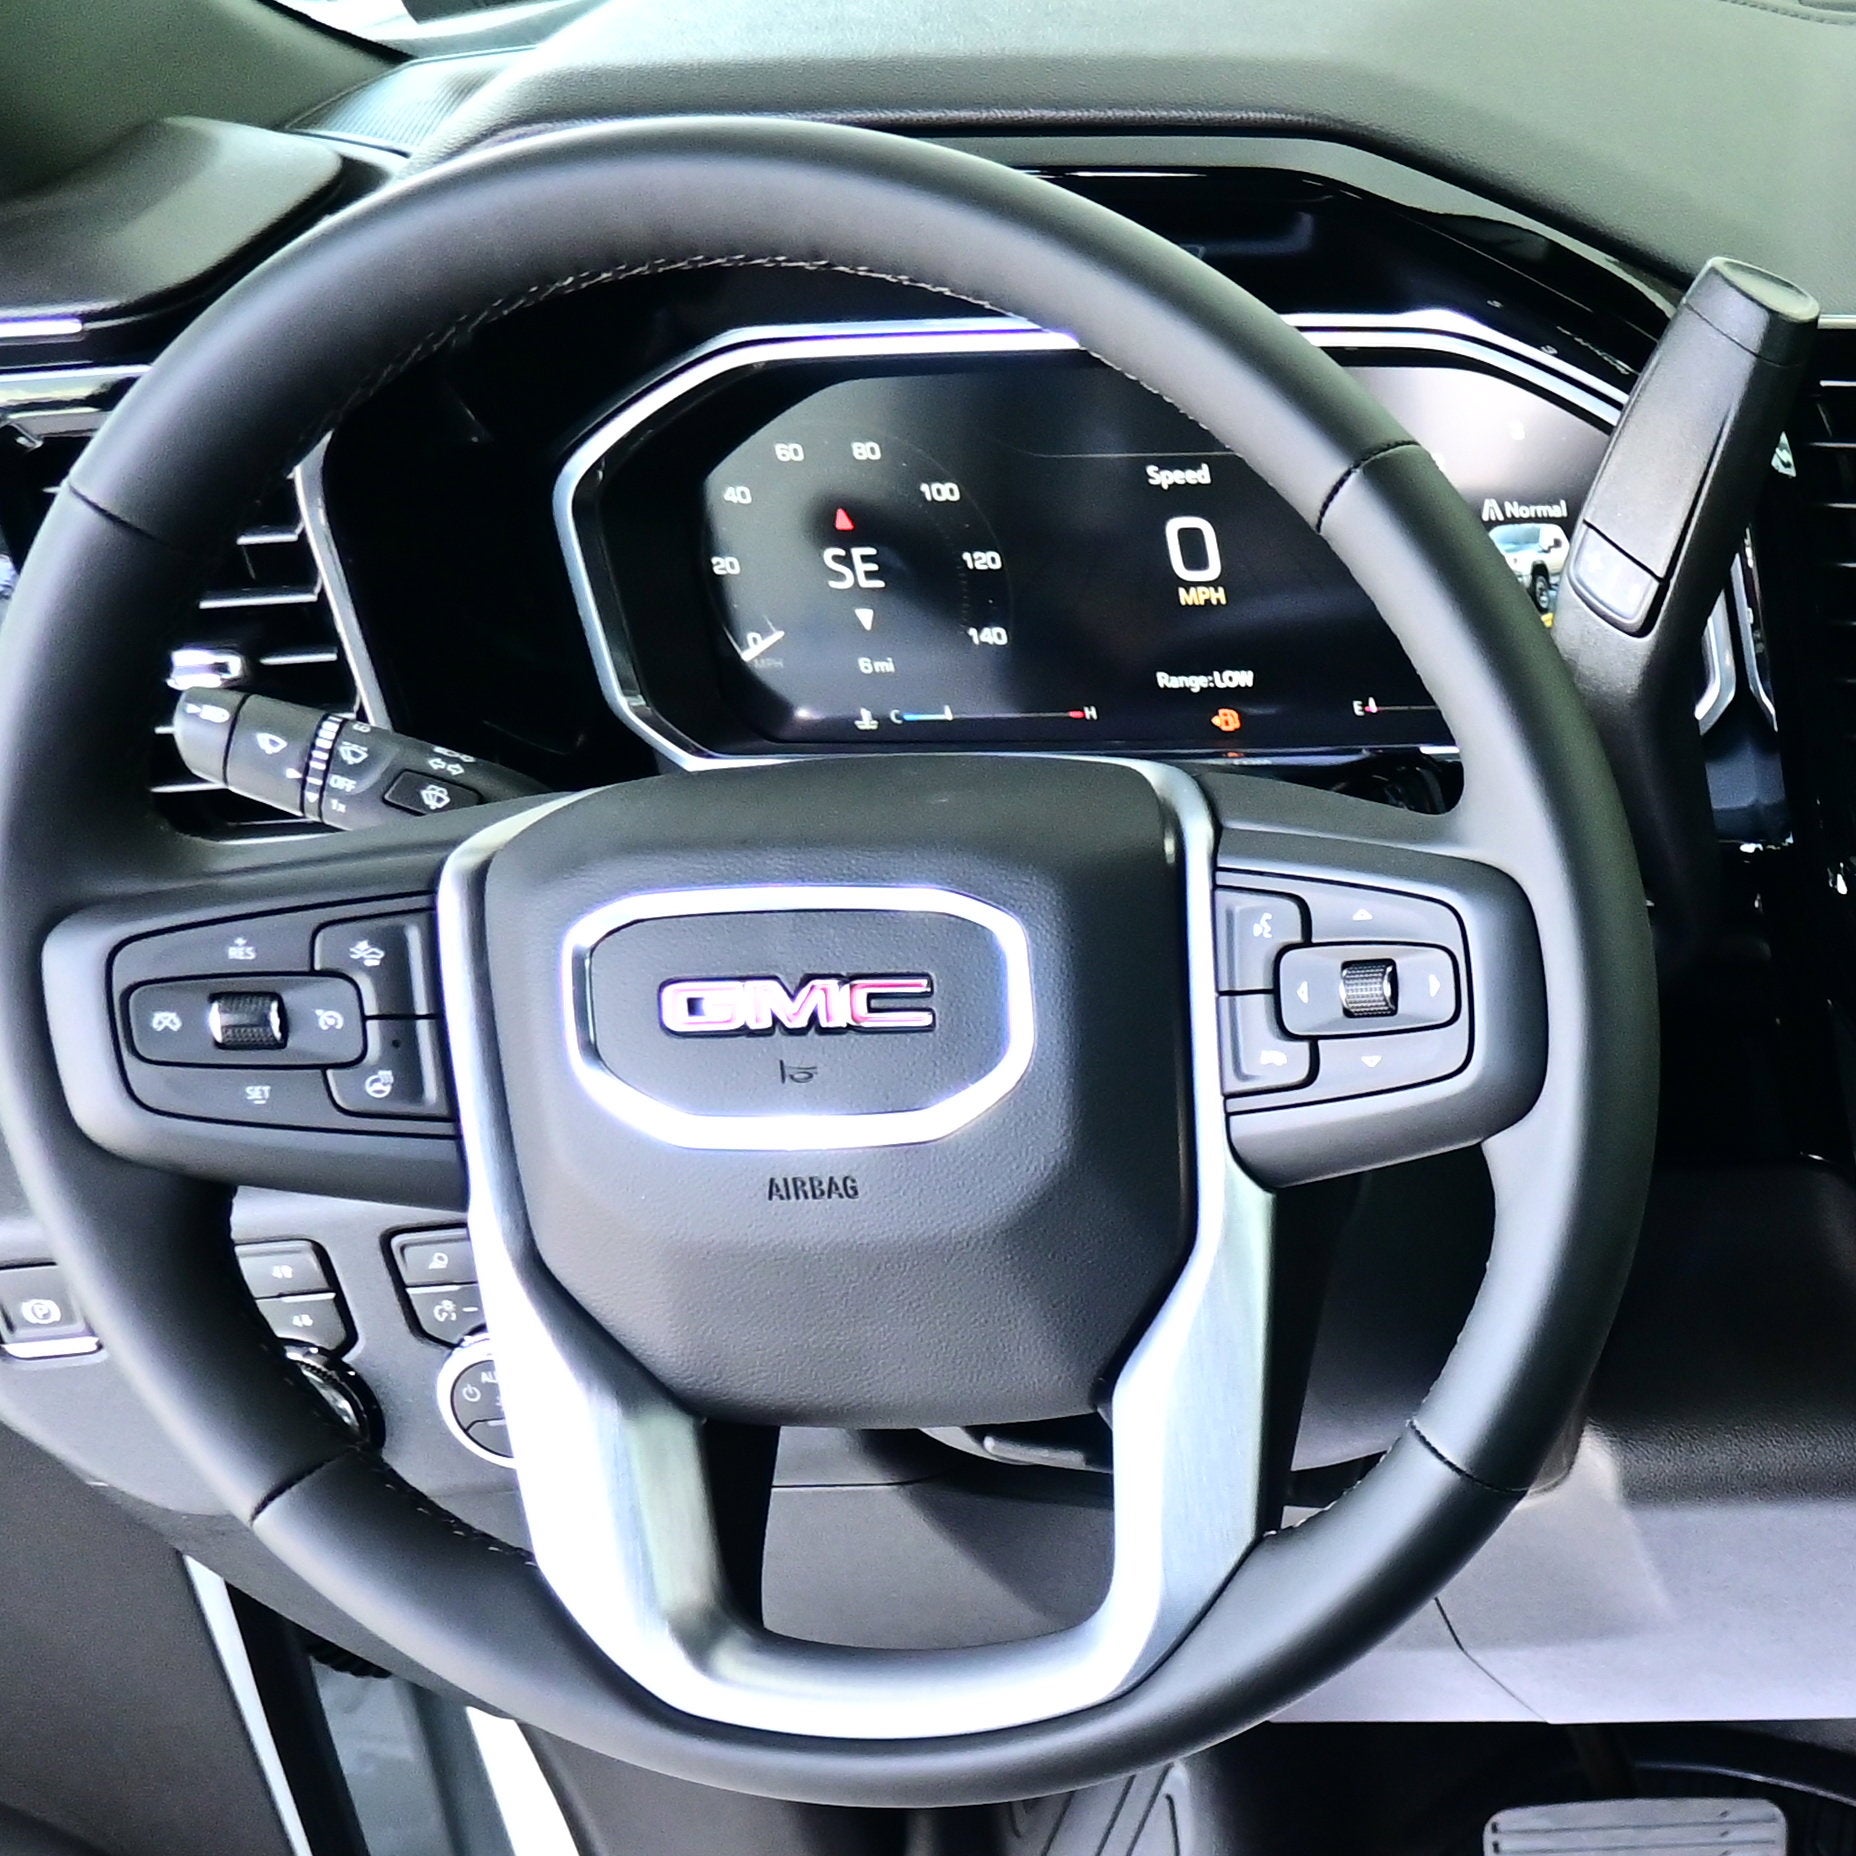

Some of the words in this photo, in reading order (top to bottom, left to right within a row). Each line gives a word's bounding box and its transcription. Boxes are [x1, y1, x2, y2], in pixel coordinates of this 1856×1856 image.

[775, 443, 804, 462] 60
[852, 442, 881, 460] 80
[1146, 463, 1211, 490] Speed
[723, 486, 752, 504] 40
[920, 482, 961, 502] 100
[1503, 499, 1568, 519] Normal
[1165, 516, 1222, 582] 0
[711, 556, 741, 575] 20
[822, 547, 885, 590] SE
[962, 551, 1002, 571] 120
[1177, 586, 1228, 606] MPH
[967, 626, 1009, 645] 140
[228, 945, 256, 961] RES
[659, 974, 936, 1036] GMC
[244, 1085, 272, 1101] SET
[766, 1174, 861, 1202] AIRBAG
